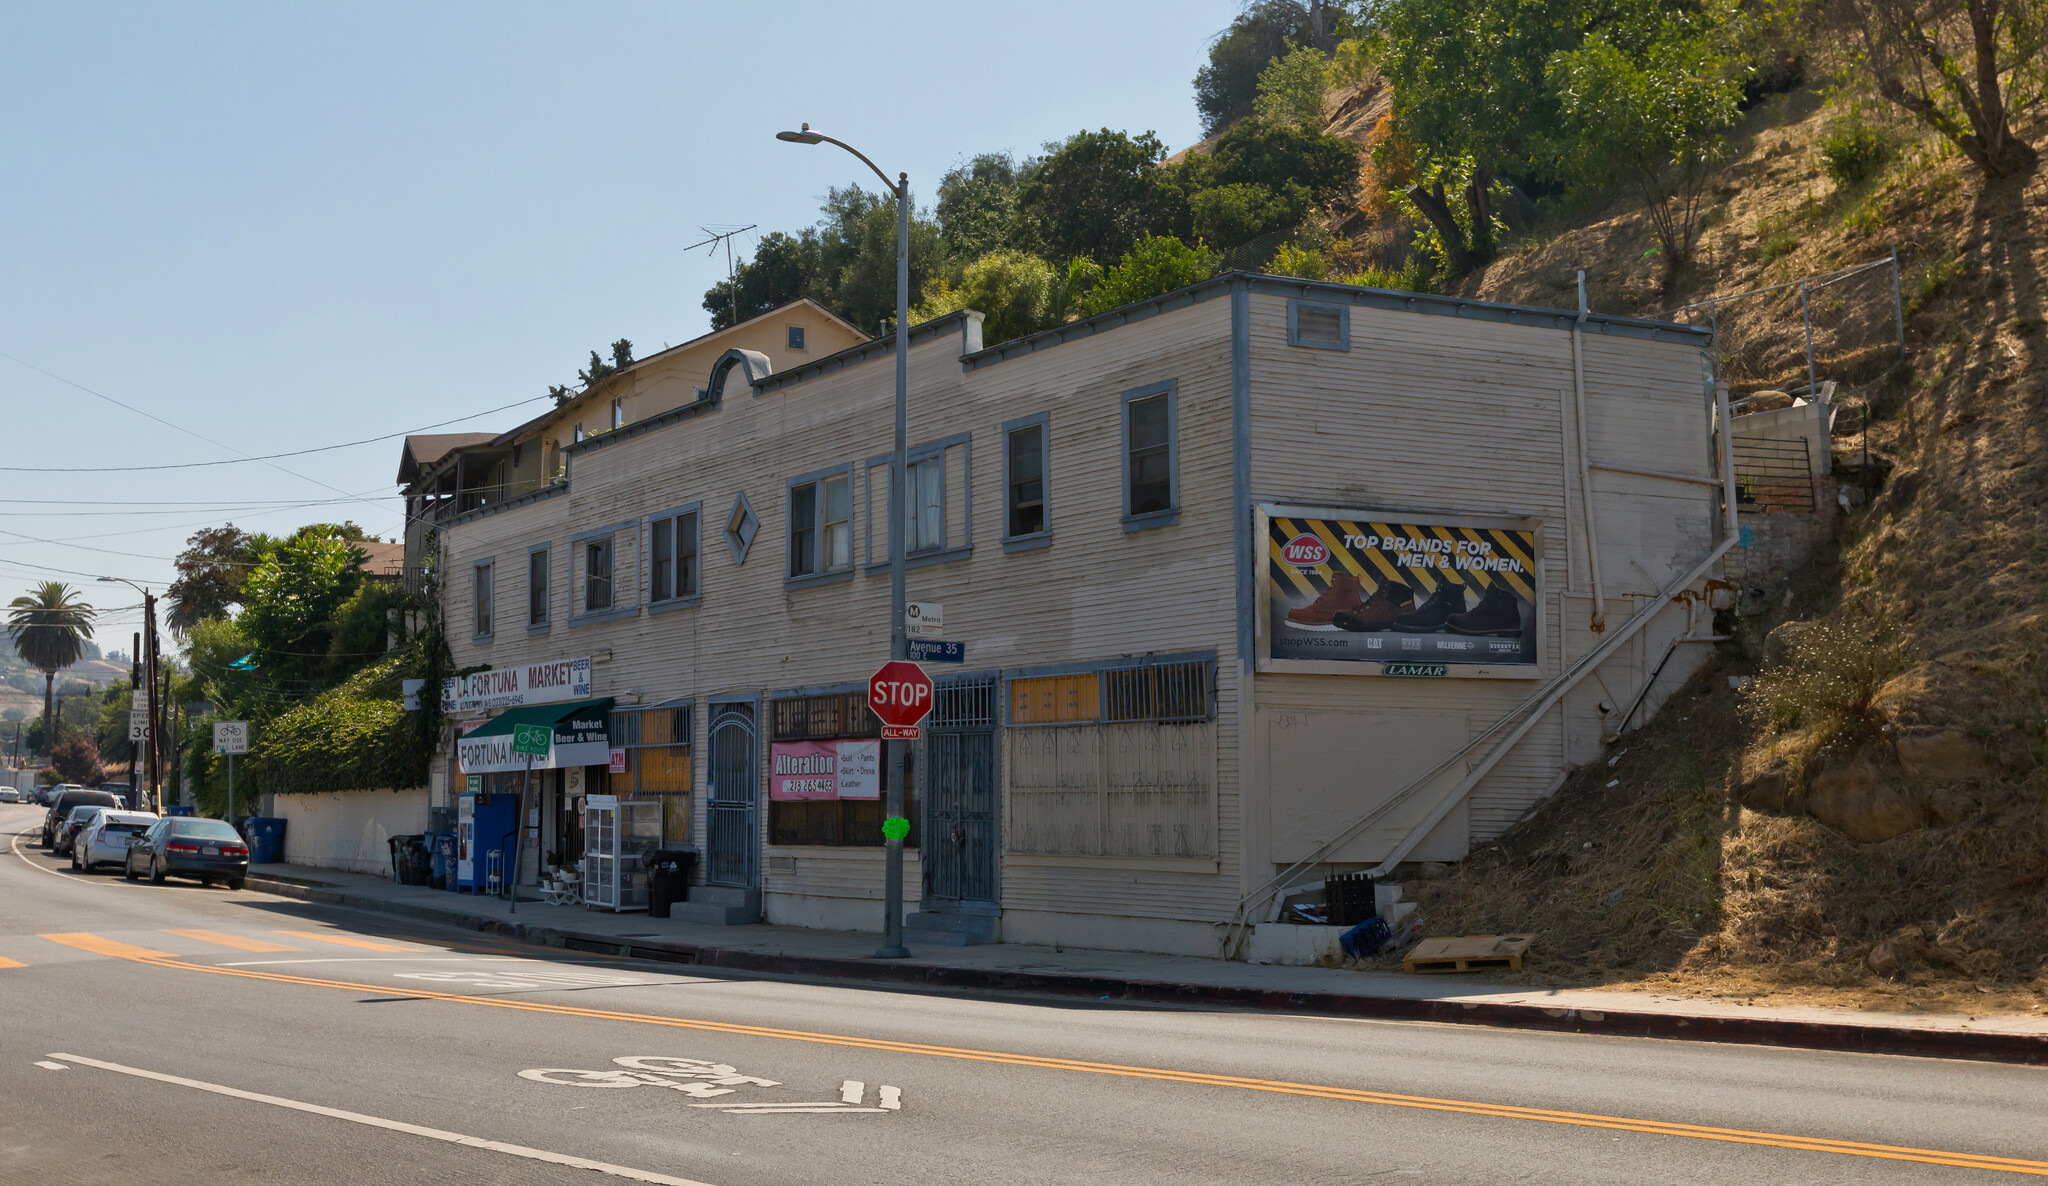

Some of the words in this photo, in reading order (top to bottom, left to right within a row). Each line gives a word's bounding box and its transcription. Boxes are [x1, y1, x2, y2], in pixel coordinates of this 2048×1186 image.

[1343, 534, 1380, 550] TOP
[1382, 537, 1453, 554] BRANDS
[1456, 540, 1492, 556] FOR
[1289, 545, 1323, 560] WSS
[1397, 553, 1436, 568] MEN
[1439, 555, 1452, 569] &
[1455, 556, 1525, 573] WOMEN.
[907, 625, 921, 634] 182
[910, 640, 942, 653] Avenue
[945, 643, 958, 655] 35
[1279, 637, 1349, 648] shopWSS.com
[1367, 638, 1382, 649] CAT
[1436, 641, 1467, 650] WOLVERINE
[909, 651, 921, 660] 100
[923, 652, 928, 660] E
[573, 659, 590, 671] BEER
[1387, 666, 1445, 676] LAMAR
[472, 670, 518, 697] FORTUNA
[528, 662, 573, 690] MARKET
[578, 672, 584, 683] &
[573, 683, 590, 696] WINE
[873, 680, 928, 707] STOP
[572, 719, 603, 730] Market
[555, 733, 576, 744] Beer
[577, 733, 585, 742] &
[586, 731, 608, 742] Wine
[883, 728, 918, 737] ALL-WAY
[461, 742, 507, 767] FORTUNA
[530, 746, 546, 754] ROUTE
[610, 752, 624, 766] ATM
[842, 754, 853, 762] Suit
[860, 754, 875, 762] Pants
[775, 752, 835, 776] Alteration
[842, 767, 854, 775] Skirt
[860, 767, 875, 775] Dress
[841, 780, 861, 788] Leather
